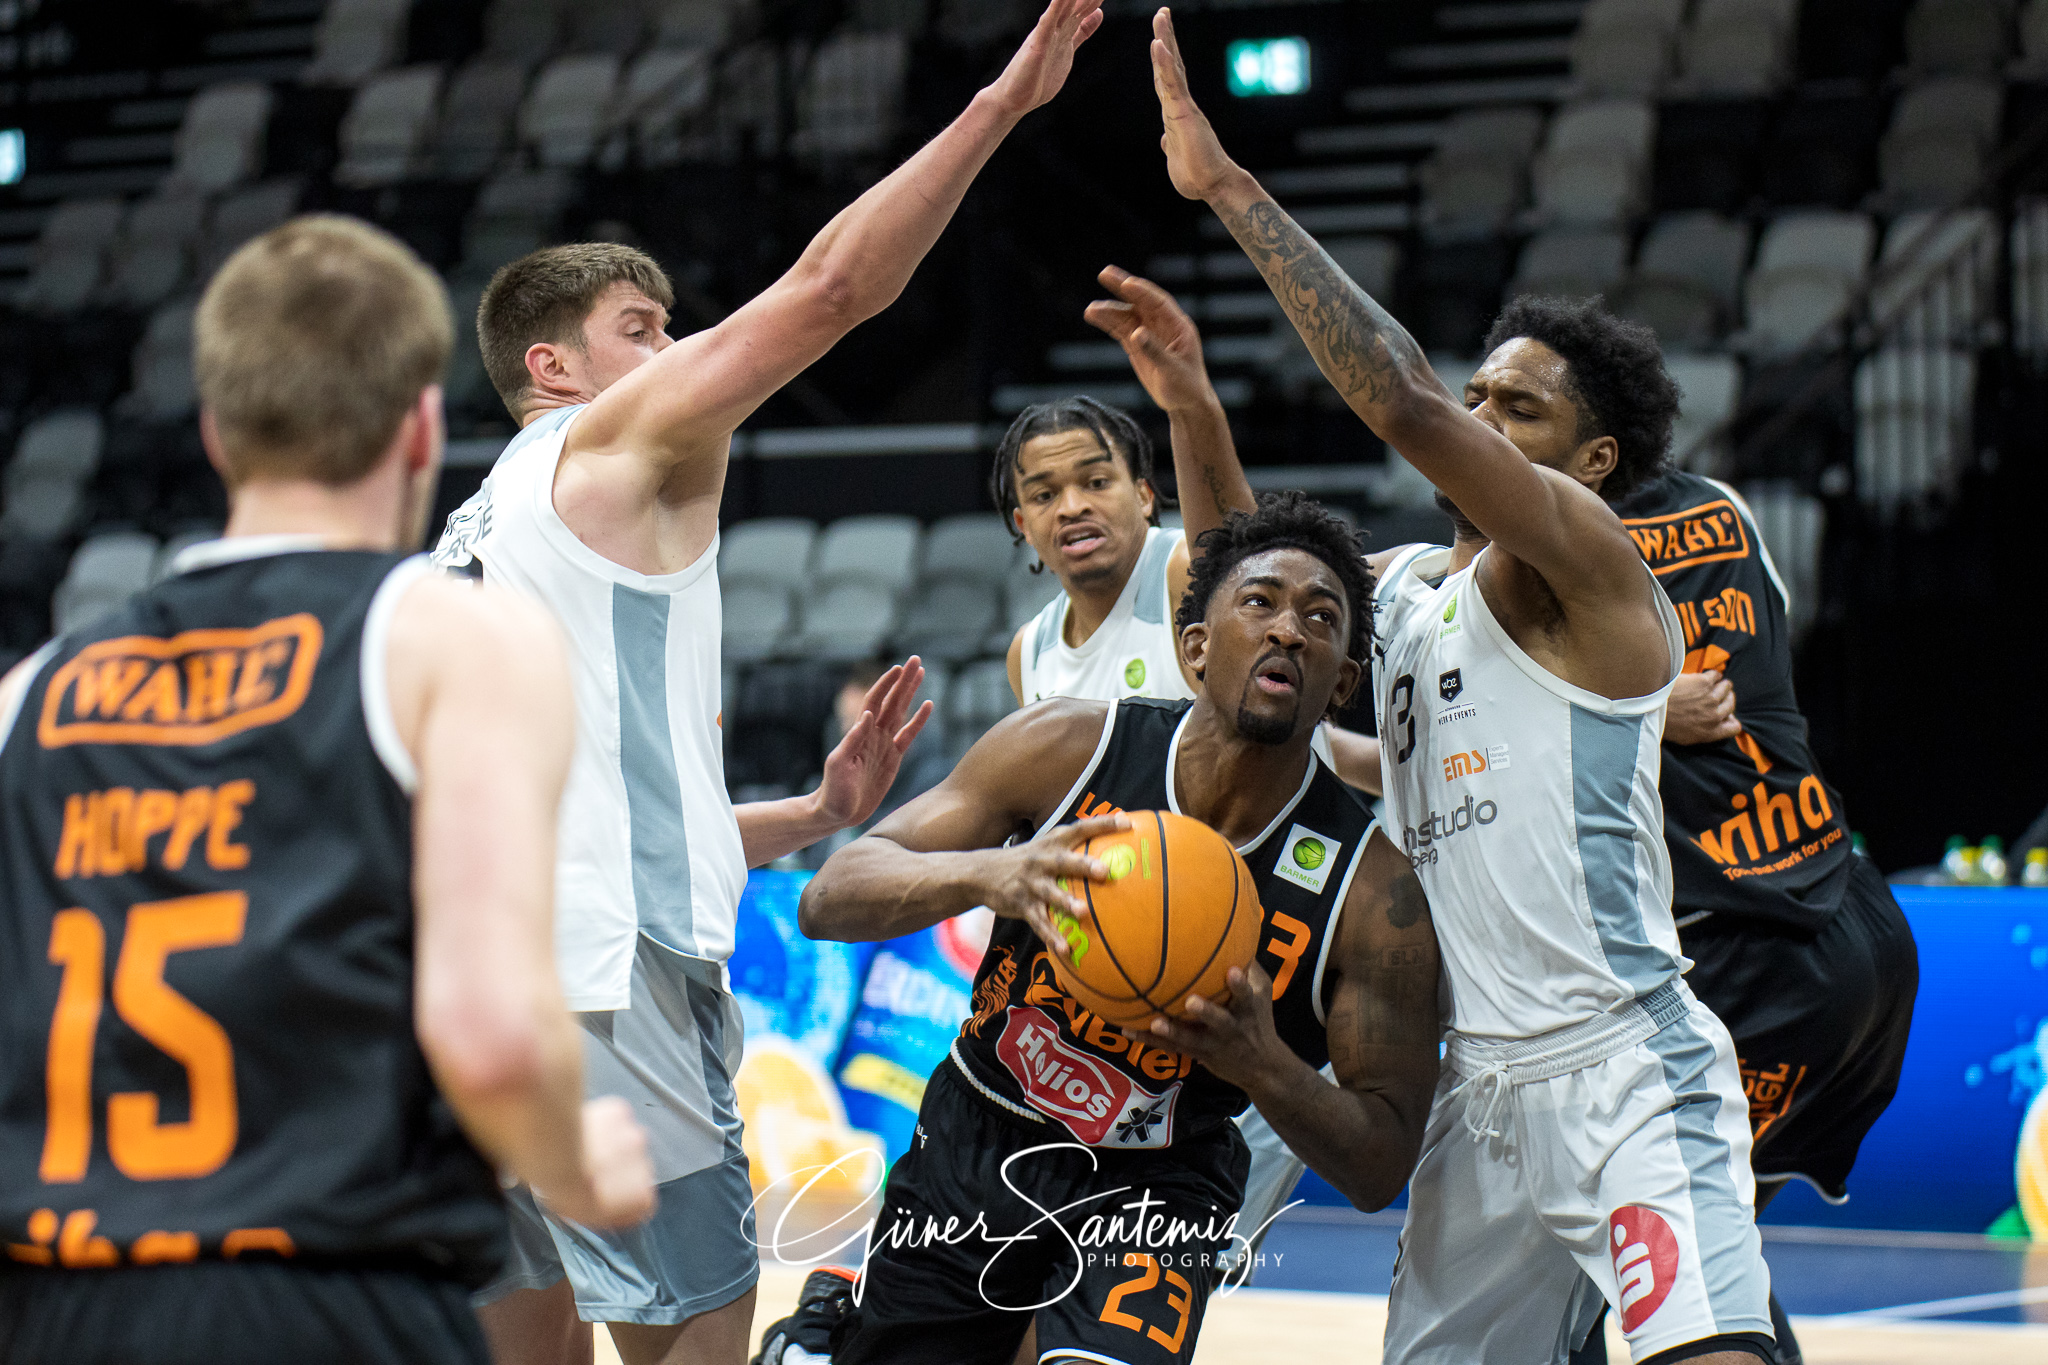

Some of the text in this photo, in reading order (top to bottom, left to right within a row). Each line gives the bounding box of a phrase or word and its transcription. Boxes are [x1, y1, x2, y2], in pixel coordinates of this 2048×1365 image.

[1454, 708, 1476, 721] EVENTS
[54, 779, 255, 879] HOPPE
[1688, 774, 1833, 865] wiha
[1773, 851, 1803, 871] work
[1801, 841, 1819, 858] for
[1820, 828, 1842, 850] you
[1279, 864, 1320, 888] BARMER
[39, 890, 249, 1184] 15
[1015, 1022, 1112, 1118] Helios
[1099, 1252, 1194, 1355] 23
